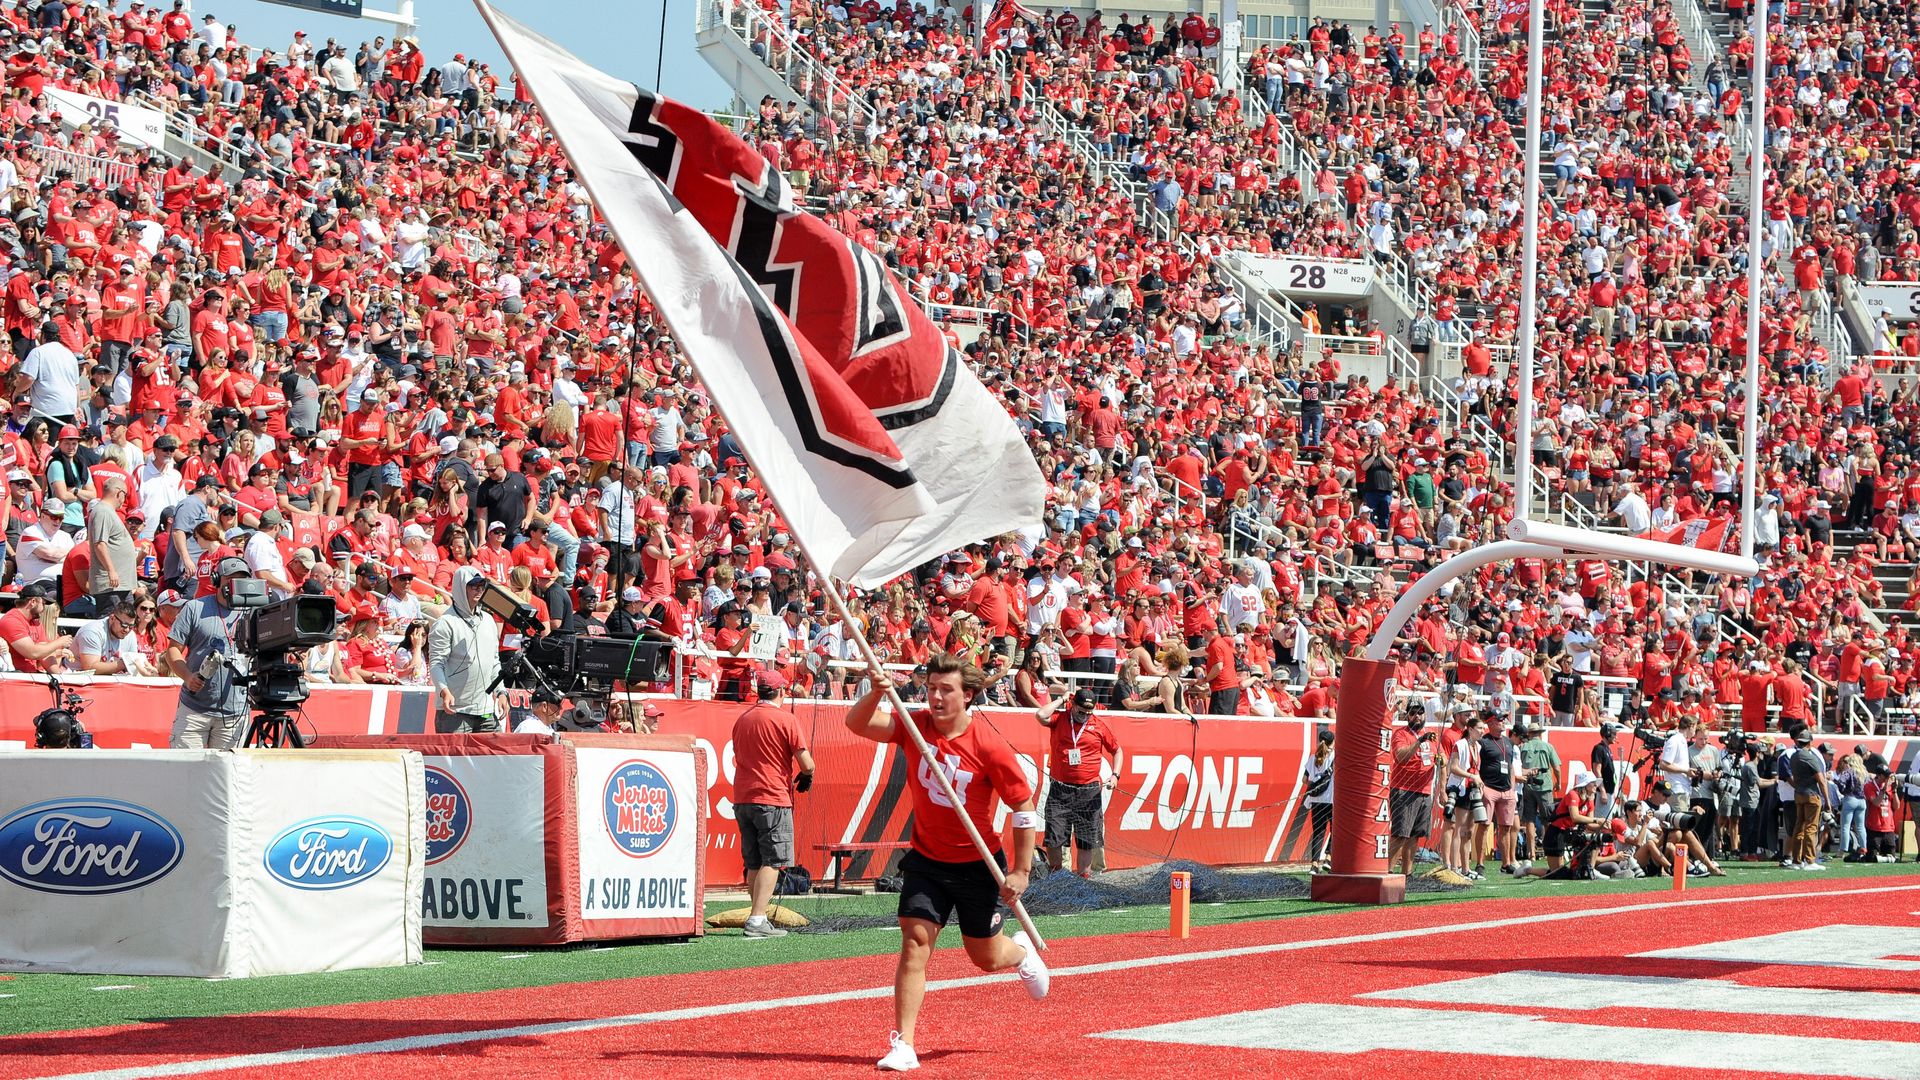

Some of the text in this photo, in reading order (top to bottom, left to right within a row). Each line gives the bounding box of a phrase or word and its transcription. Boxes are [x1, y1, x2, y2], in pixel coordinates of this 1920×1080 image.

[86, 101, 121, 131] 25
[145, 124, 159, 134] N26
[1290, 264, 1326, 289] 28
[1350, 276, 1366, 284] N29
[1868, 298, 1884, 306] E30
[1396, 319, 1404, 334] 29
[155, 366, 170, 386] 15
[1302, 386, 1319, 400] 82
[1287, 570, 1298, 585] 15
[1241, 595, 1257, 611] 92
[1557, 677, 1574, 685] UTAH
[1561, 685, 1567, 695] 6
[426, 776, 439, 785] 956
[626, 770, 641, 778] SINCE
[612, 775, 668, 813] Jersey
[1119, 753, 1264, 832] ZONE
[1375, 728, 1392, 859] UTAH
[616, 803, 667, 836] Mike's
[21, 811, 142, 877] Ford
[629, 837, 651, 849] SUBS
[289, 827, 369, 879] Ford
[585, 878, 596, 910] A
[602, 877, 631, 910] SUB
